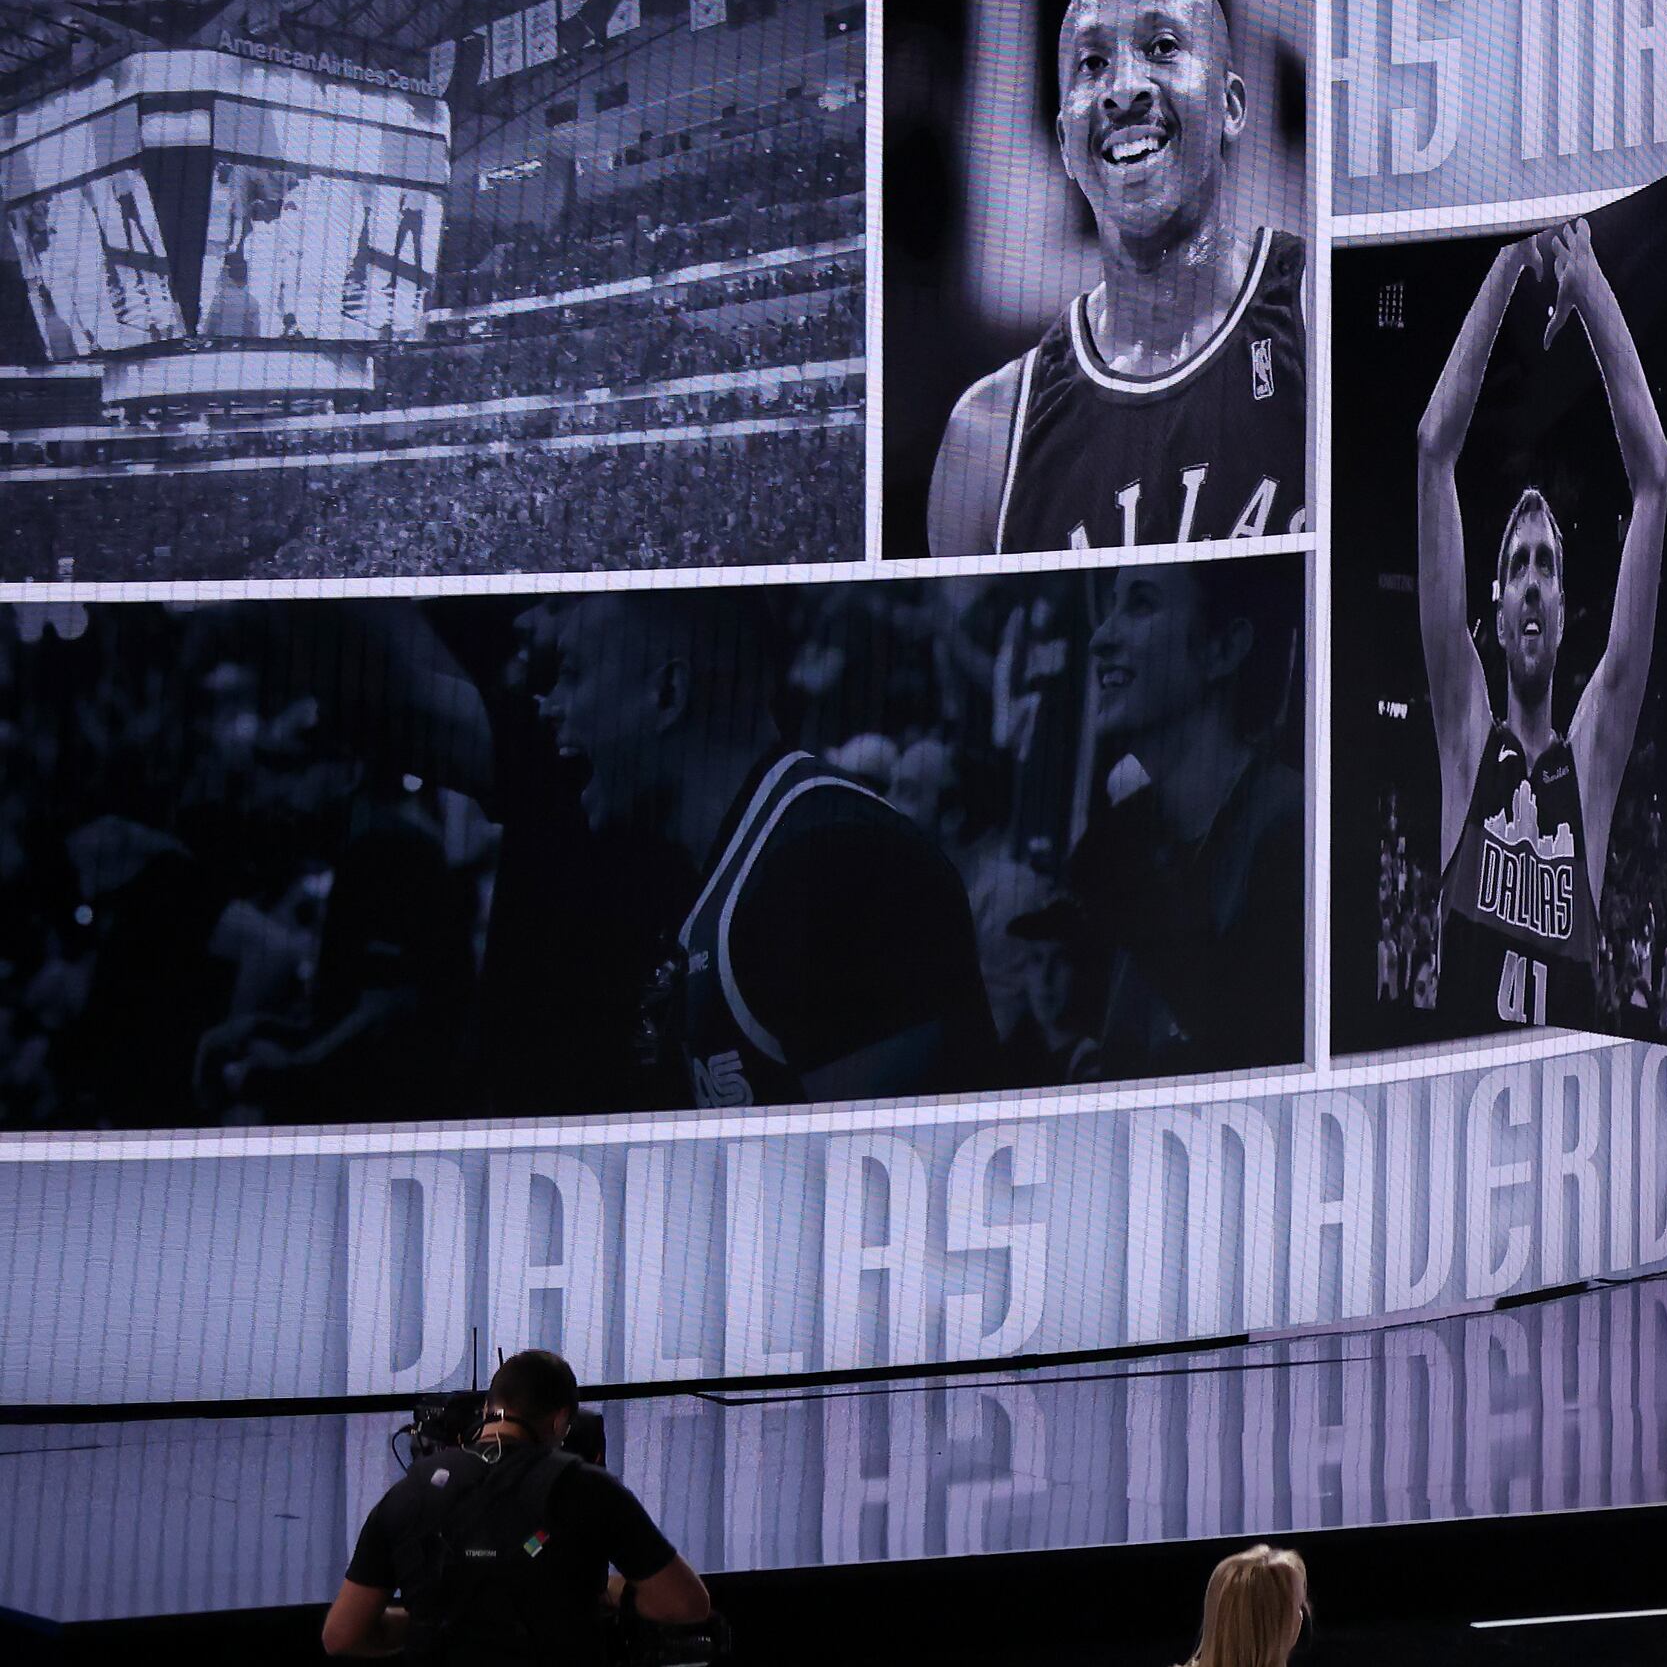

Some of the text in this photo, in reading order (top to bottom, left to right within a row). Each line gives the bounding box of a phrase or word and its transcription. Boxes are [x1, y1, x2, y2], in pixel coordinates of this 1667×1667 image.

[1477, 839, 1573, 940] DALLAS
[1497, 949, 1548, 1026] 41
[346, 1122, 1049, 1397] DALLAS
